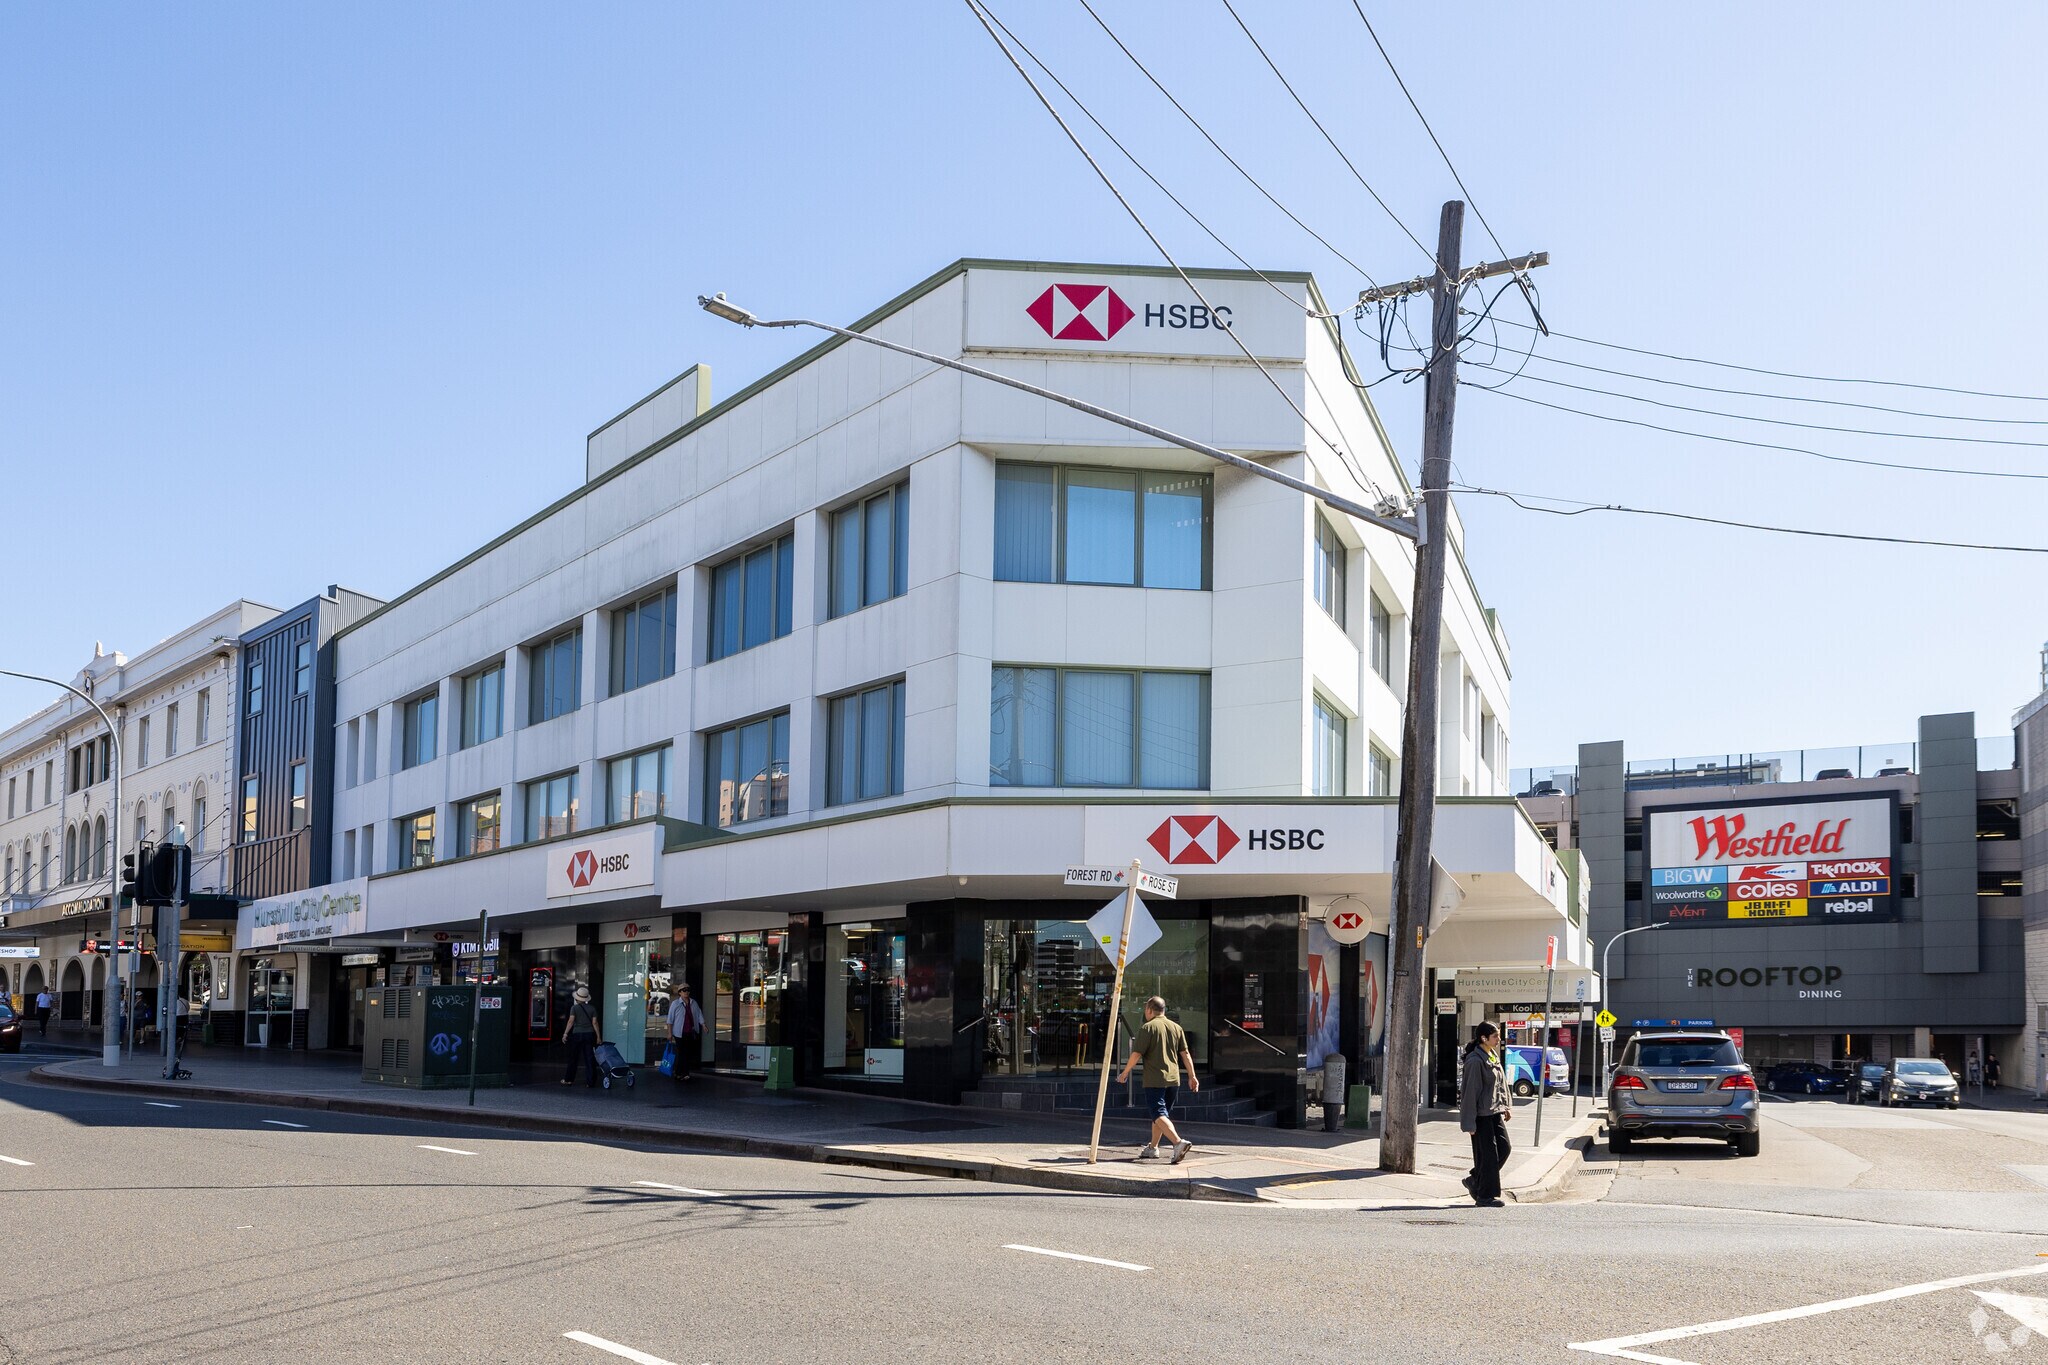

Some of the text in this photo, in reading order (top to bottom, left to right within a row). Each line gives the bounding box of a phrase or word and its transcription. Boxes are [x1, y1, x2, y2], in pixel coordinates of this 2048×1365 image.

[1145, 303, 1233, 330] HSBC
[1249, 829, 1325, 850] HSBC
[1686, 813, 1852, 861] Westfield
[600, 853, 630, 873] HSBC
[1066, 869, 1112, 882] FOREST RD
[1148, 877, 1177, 894] ROSE ST
[1838, 880, 1878, 893] ALDI
[61, 897, 105, 917] ACCOMMODATION
[1744, 901, 1761, 909] JB
[1748, 908, 1787, 917] HOME
[1825, 898, 1873, 914] rebel
[284, 930, 299, 941] FOREST
[315, 925, 332, 936] ARCADE
[639, 925, 652, 933] HSBC
[461, 938, 499, 954] KTM OBIL
[1458, 978, 1564, 988] HurstvilleCityCenre
[1697, 965, 1842, 987] ROOFTOP
[1799, 990, 1842, 998] DINING
[1512, 1004, 1533, 1012] Kool
